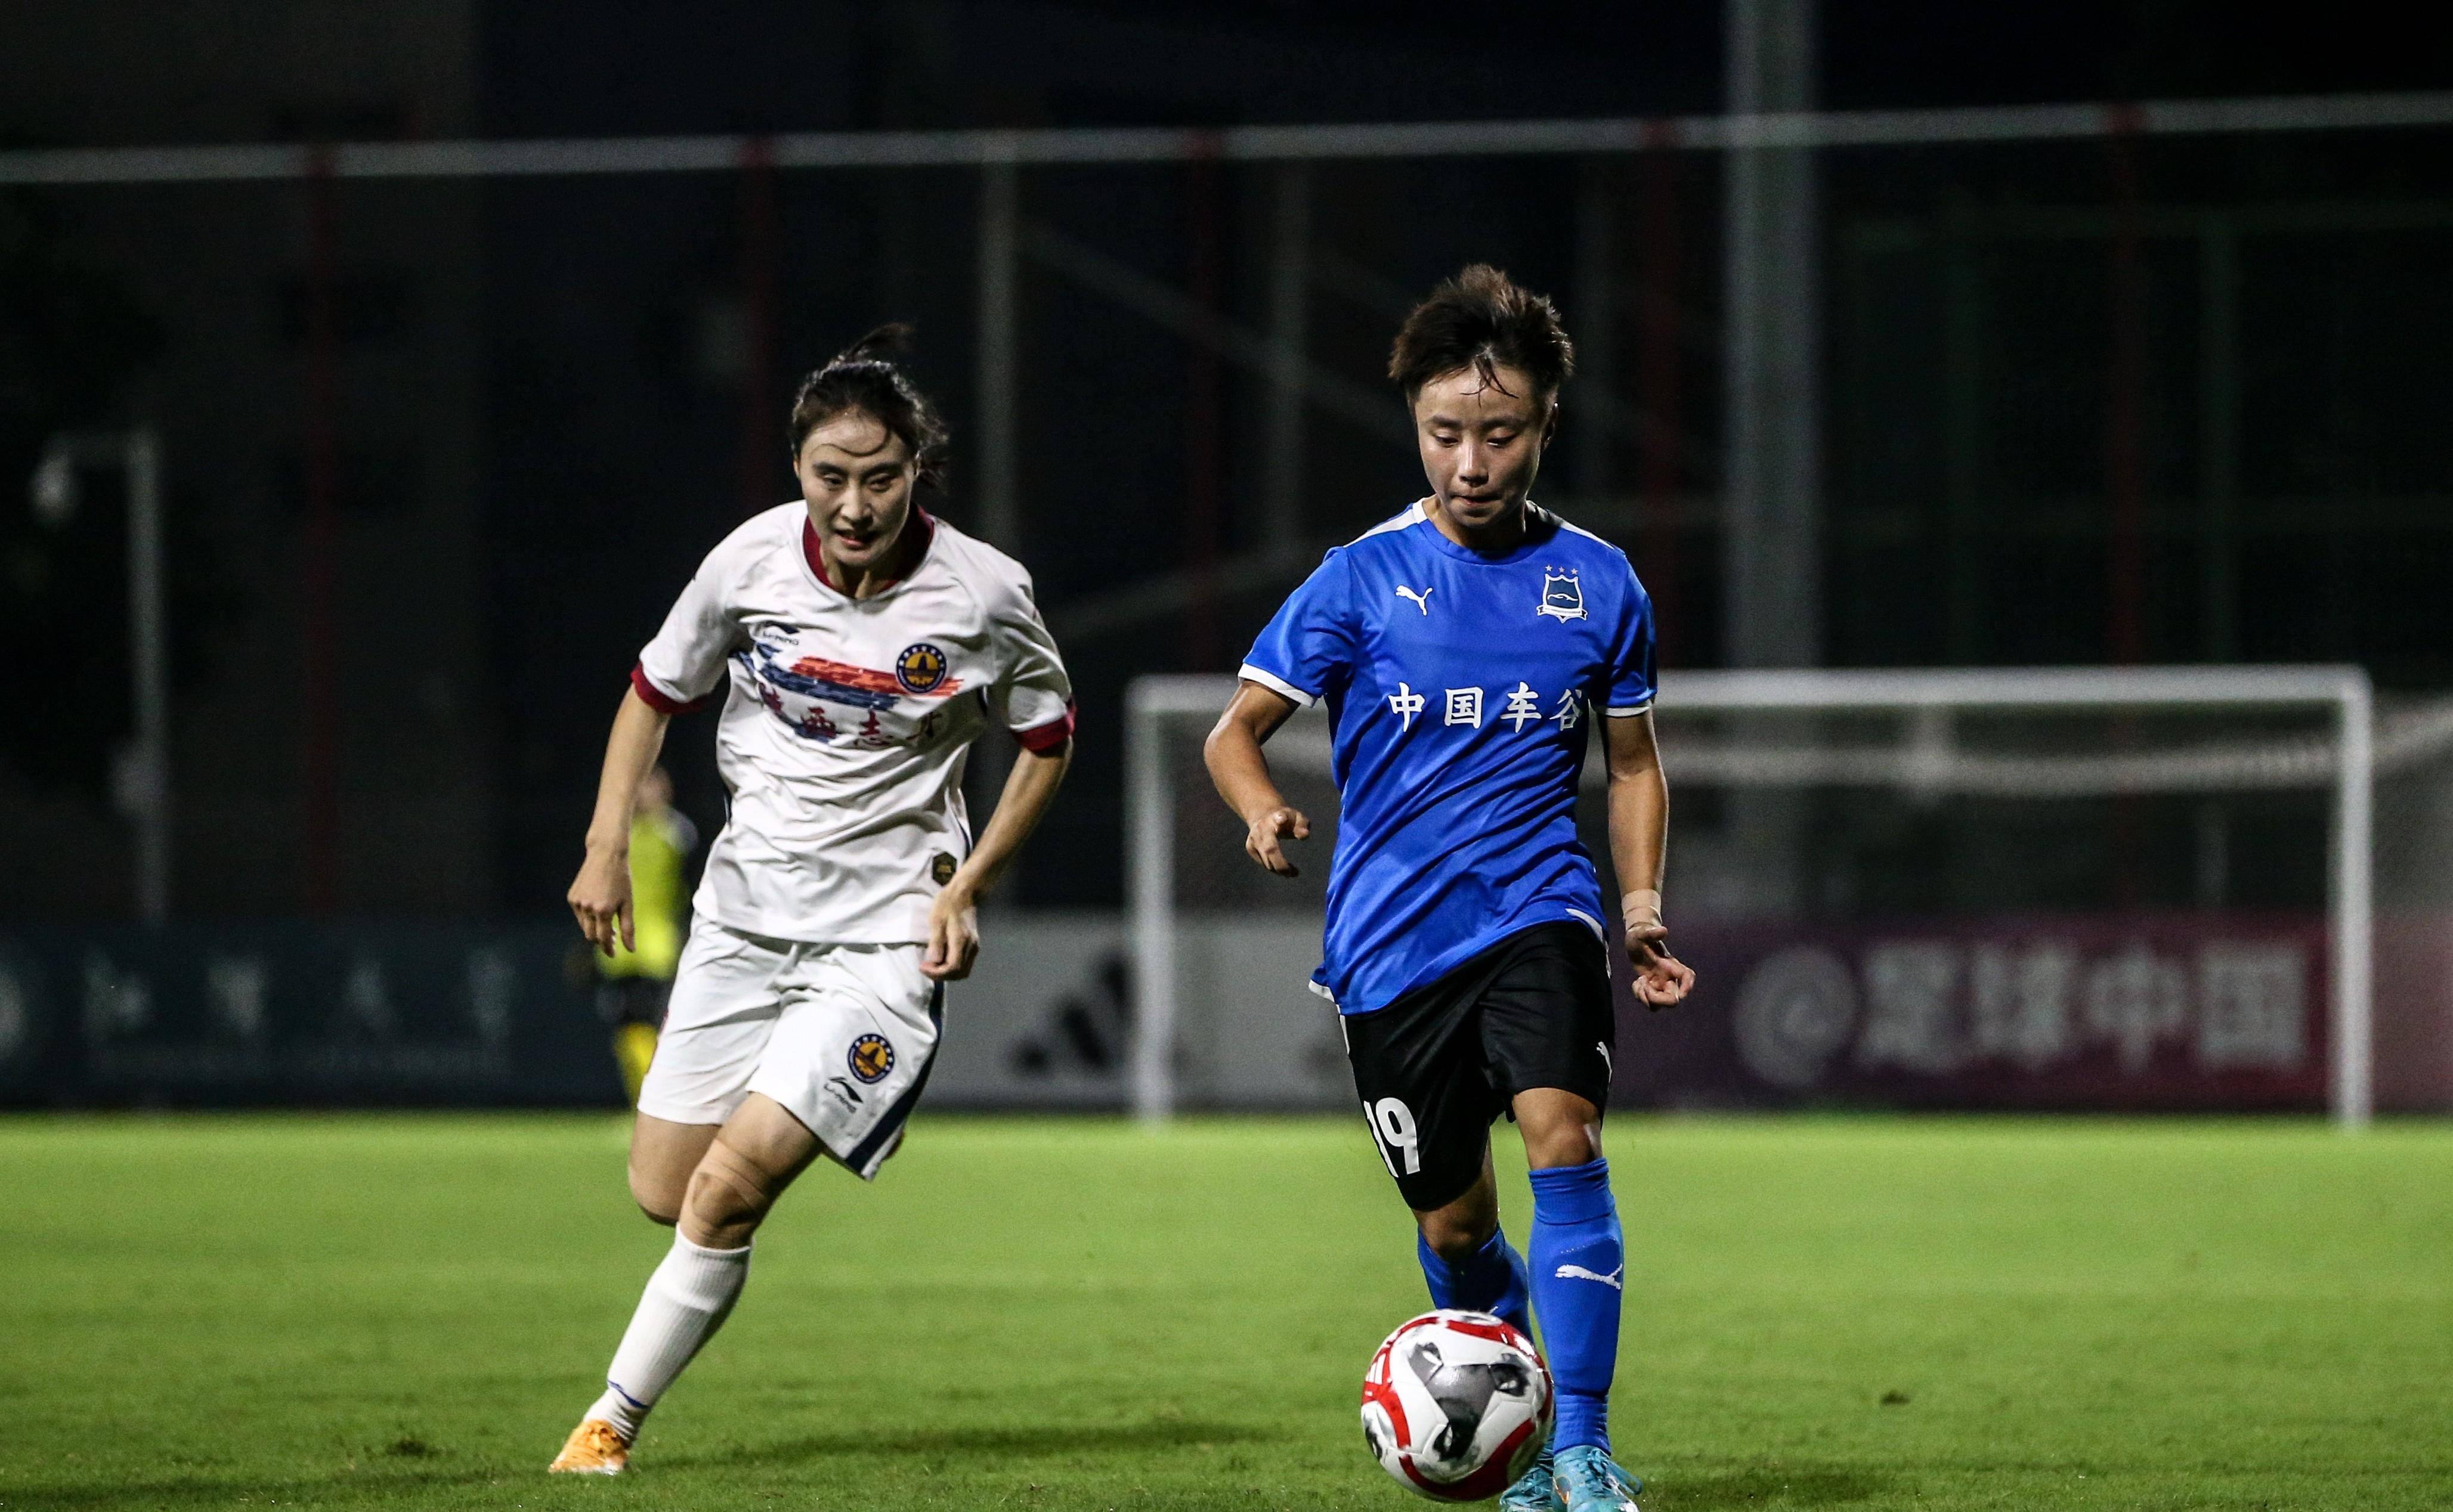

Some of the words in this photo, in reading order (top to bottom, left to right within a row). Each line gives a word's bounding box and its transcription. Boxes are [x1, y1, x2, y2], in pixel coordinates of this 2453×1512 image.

[1387, 681, 1583, 733] 中国车谷
[1363, 1097, 1420, 1178] 19
